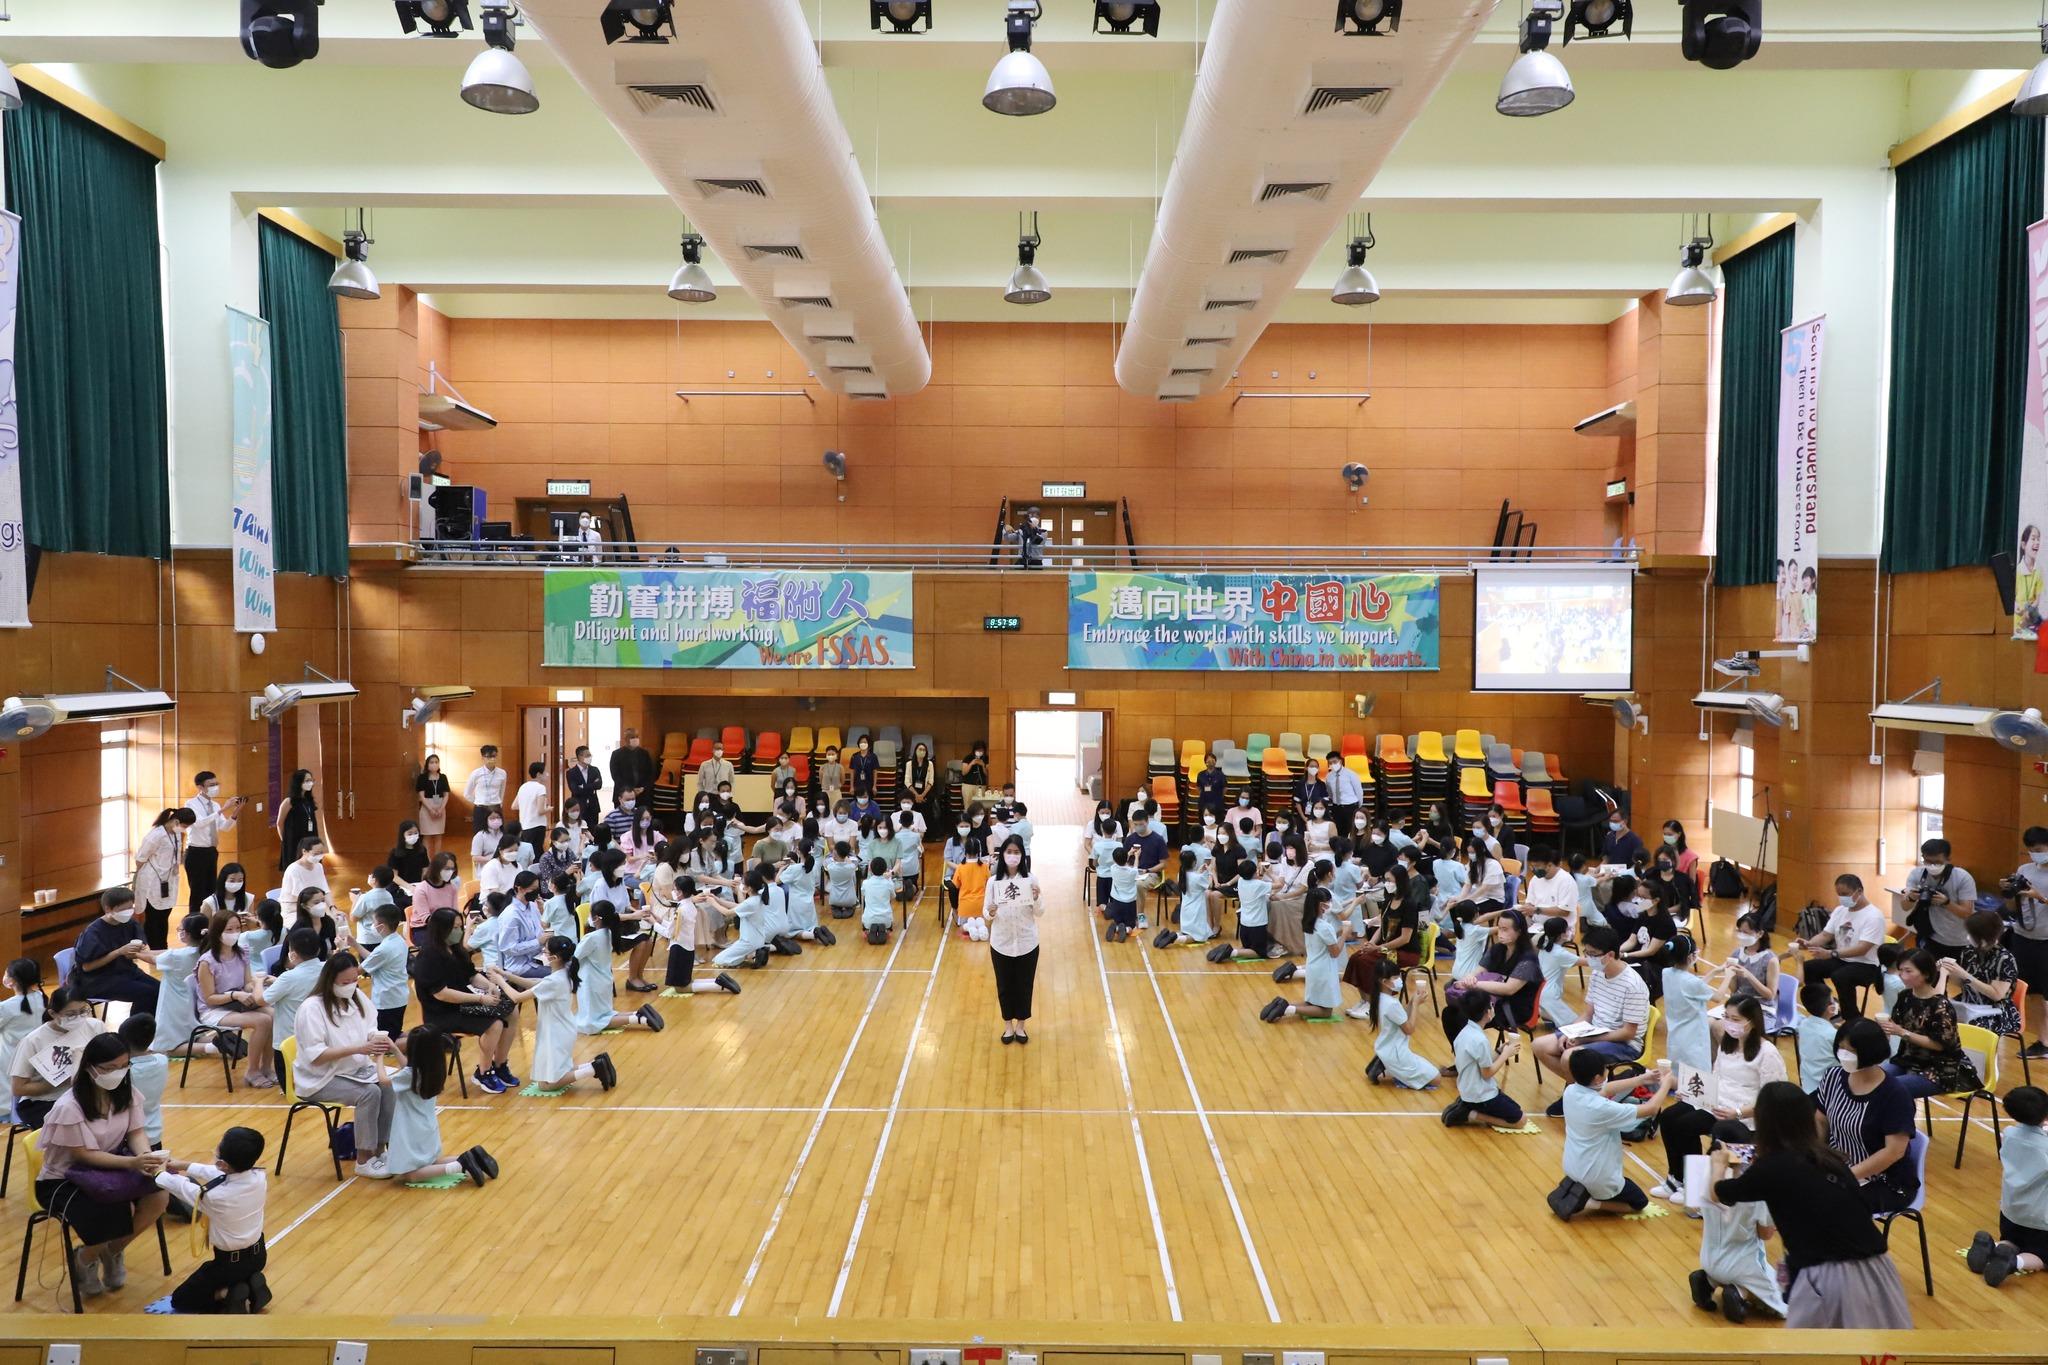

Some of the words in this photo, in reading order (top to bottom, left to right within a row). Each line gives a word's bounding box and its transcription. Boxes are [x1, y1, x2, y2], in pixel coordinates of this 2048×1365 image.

[244, 586, 272, 618] Win
[1109, 580, 1391, 623] 邁向世界中國心
[575, 620, 637, 646] Diligent
[640, 623, 670, 642] and
[674, 623, 779, 646] hardworking,
[1083, 622, 1151, 644] Embrace
[1154, 624, 1181, 644] the
[1183, 624, 1227, 644] world
[1231, 625, 1265, 644] with
[1269, 624, 1313, 644] skills
[1316, 630, 1336, 644] we
[1340, 625, 1399, 649] impart,
[758, 646, 782, 666] We
[786, 650, 813, 666] are
[816, 634, 894, 666] FSSAS.
[1227, 647, 1265, 667] With
[1269, 647, 1313, 667] China
[1319, 649, 1335, 667] in
[1338, 654, 1367, 667] our
[1370, 648, 1427, 667] hearts.
[1687, 1072, 1705, 1098] 孝
